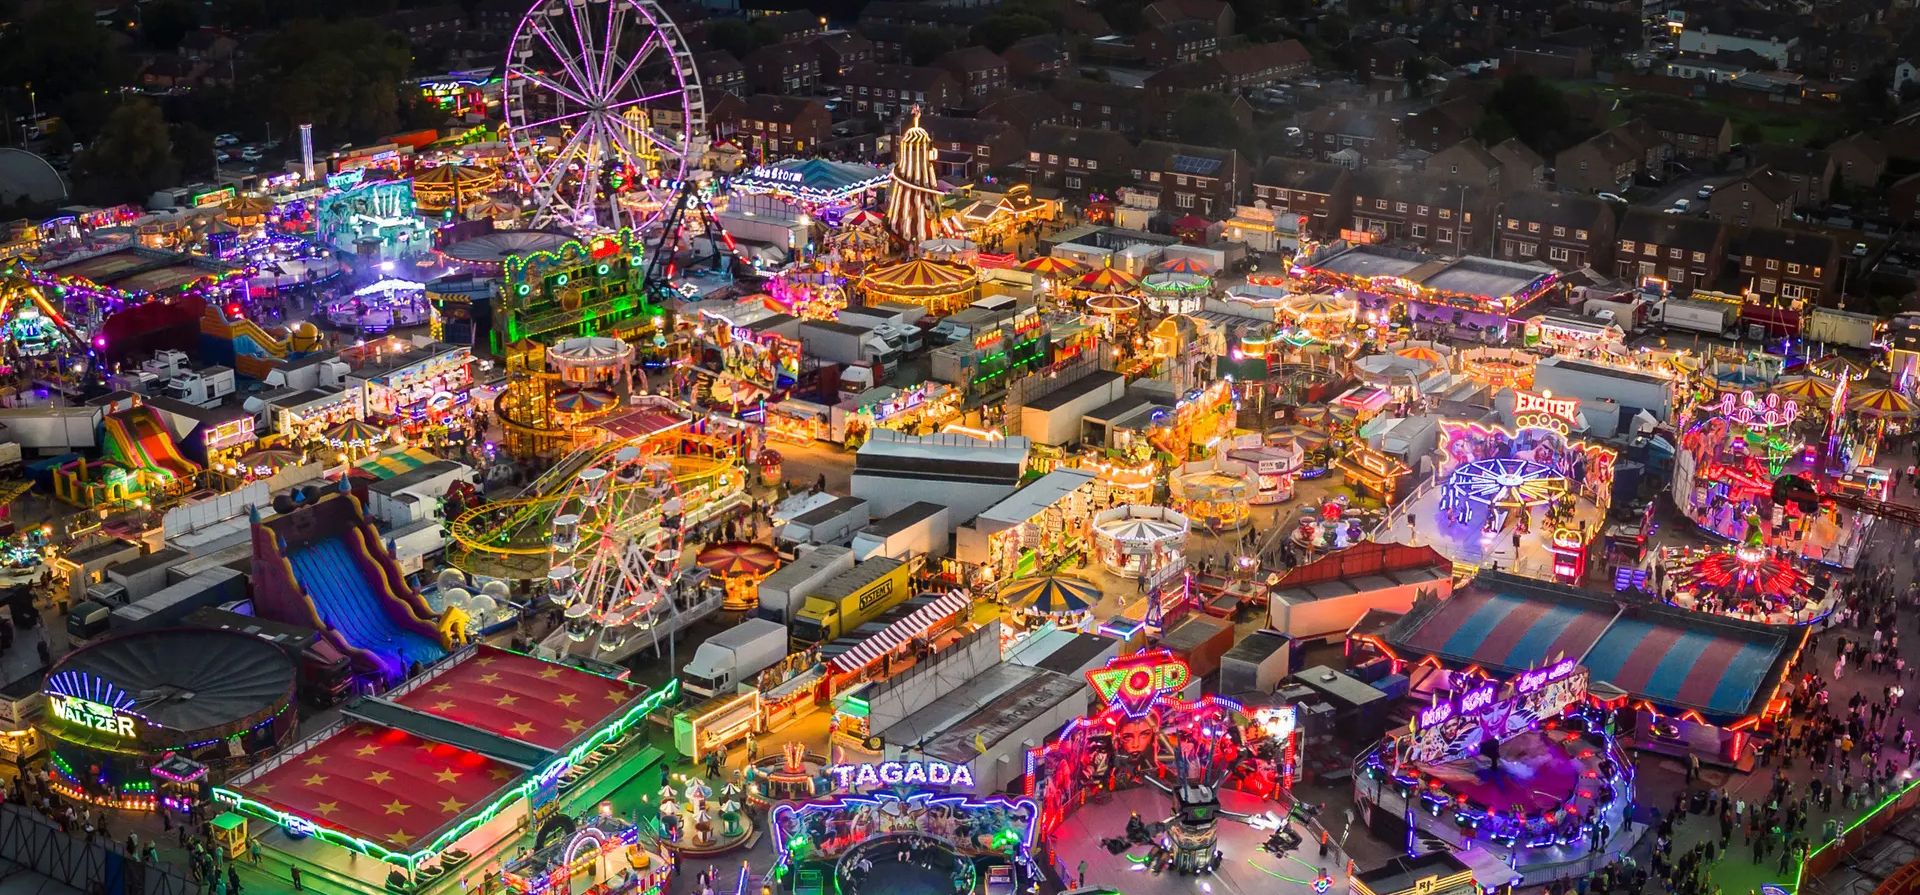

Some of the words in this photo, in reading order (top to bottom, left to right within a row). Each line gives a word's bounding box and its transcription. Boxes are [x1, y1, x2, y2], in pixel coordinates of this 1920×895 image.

[1515, 389, 1577, 425] EXCITER
[1091, 663, 1186, 702] VOID
[50, 696, 136, 738] WALTZER
[833, 761, 975, 787] TAGADA
